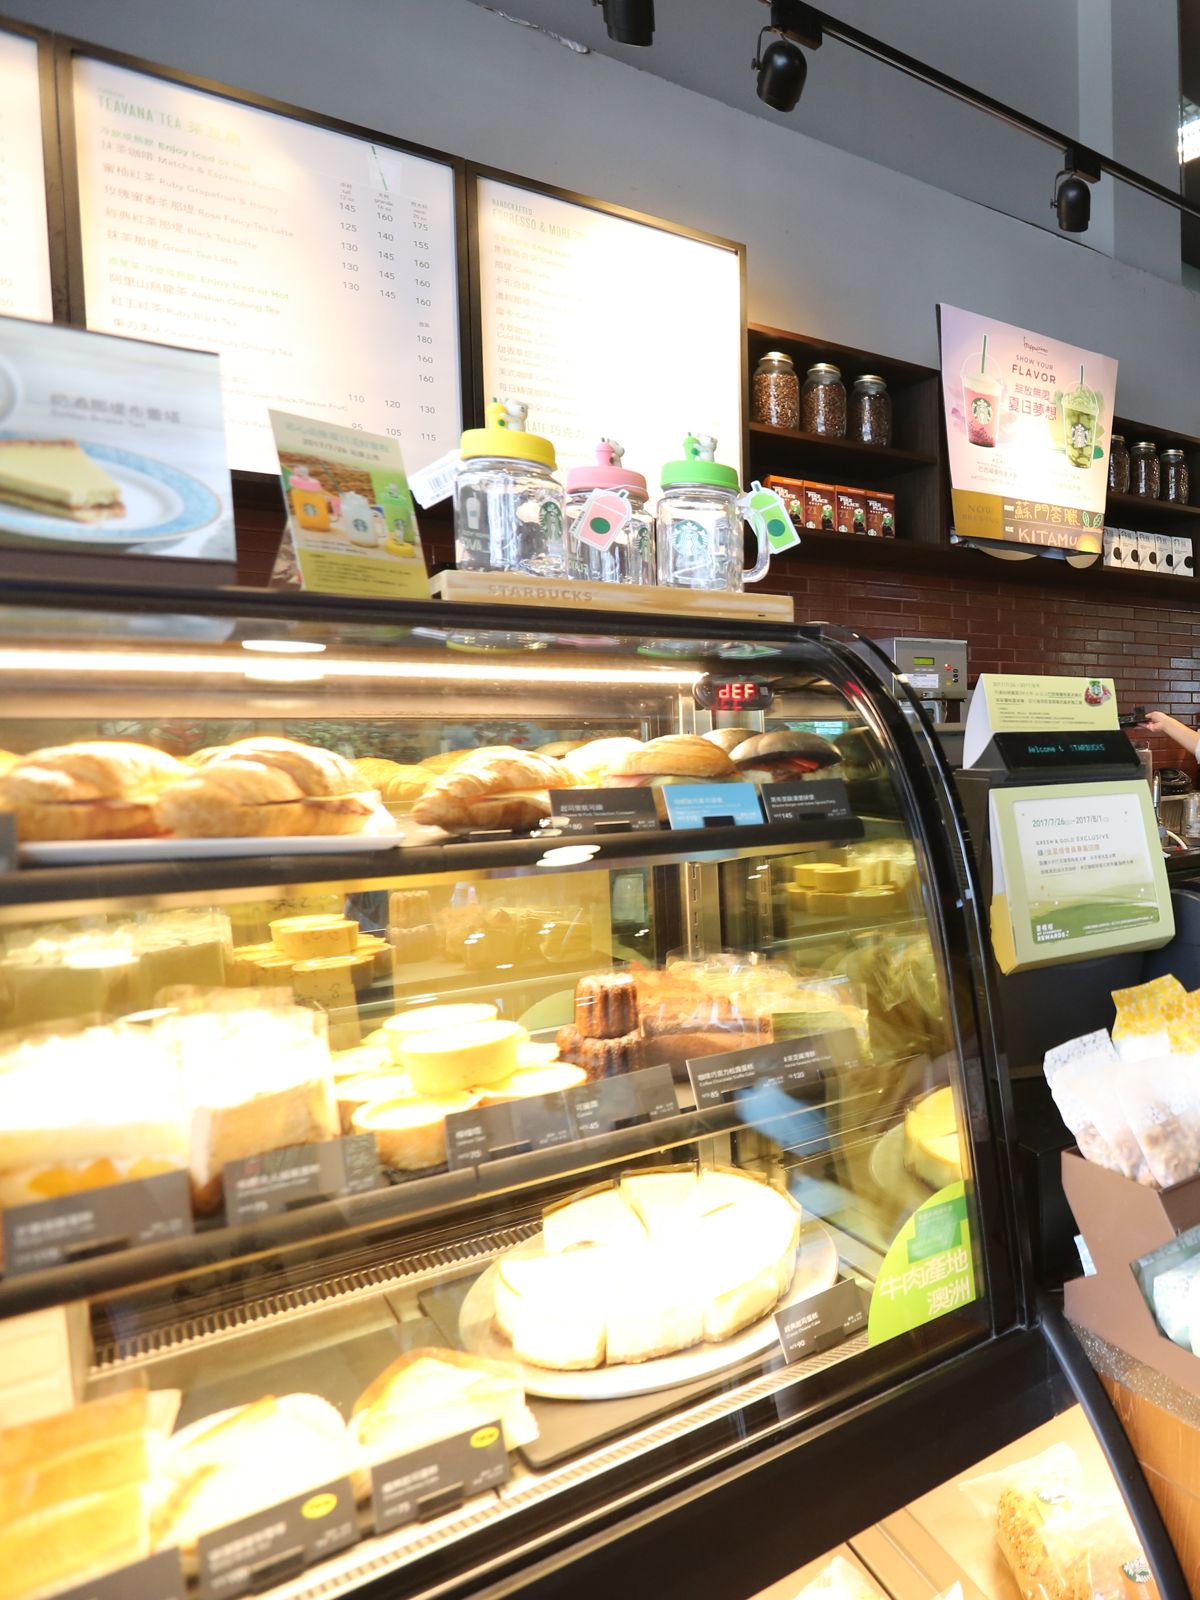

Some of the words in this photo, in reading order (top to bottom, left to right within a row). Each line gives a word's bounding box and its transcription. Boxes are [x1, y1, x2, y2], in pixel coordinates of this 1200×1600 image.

[97, 95, 154, 123] TEAVANA
[160, 112, 182, 129] TEA
[339, 203, 356, 213] 145
[377, 212, 393, 223] 160
[412, 222, 428, 232] 175
[340, 222, 357, 233] 125
[377, 231, 394, 242] 140
[413, 240, 429, 251] 155
[341, 242, 358, 253] 130
[378, 251, 395, 262] 145
[414, 259, 430, 270] 160
[342, 261, 359, 272] 130
[379, 270, 395, 281] 145
[415, 278, 431, 289] 160
[342, 281, 360, 292] 130
[380, 289, 396, 300] 145
[415, 297, 431, 308] 160
[417, 335, 433, 345] 180
[417, 354, 433, 364] 160
[1016, 354, 1035, 366] SHOW
[1037, 360, 1054, 371] YOUR
[418, 374, 434, 384] 160
[1011, 363, 1057, 385] FLAVOR
[348, 394, 365, 404] 110
[385, 400, 401, 409] 120
[420, 405, 436, 415] 130
[1008, 395, 1057, 422] 夏日夢想
[351, 422, 363, 432] 95
[386, 427, 402, 437] 105
[421, 432, 436, 442] 115
[1014, 500, 1081, 527] 蘇門答臘
[1018, 527, 1077, 547] KITAMU
[487, 583, 593, 602] STARBUCKS
[879, 1248, 969, 1302] 牛肉產地
[927, 1276, 971, 1317] 澳洲
